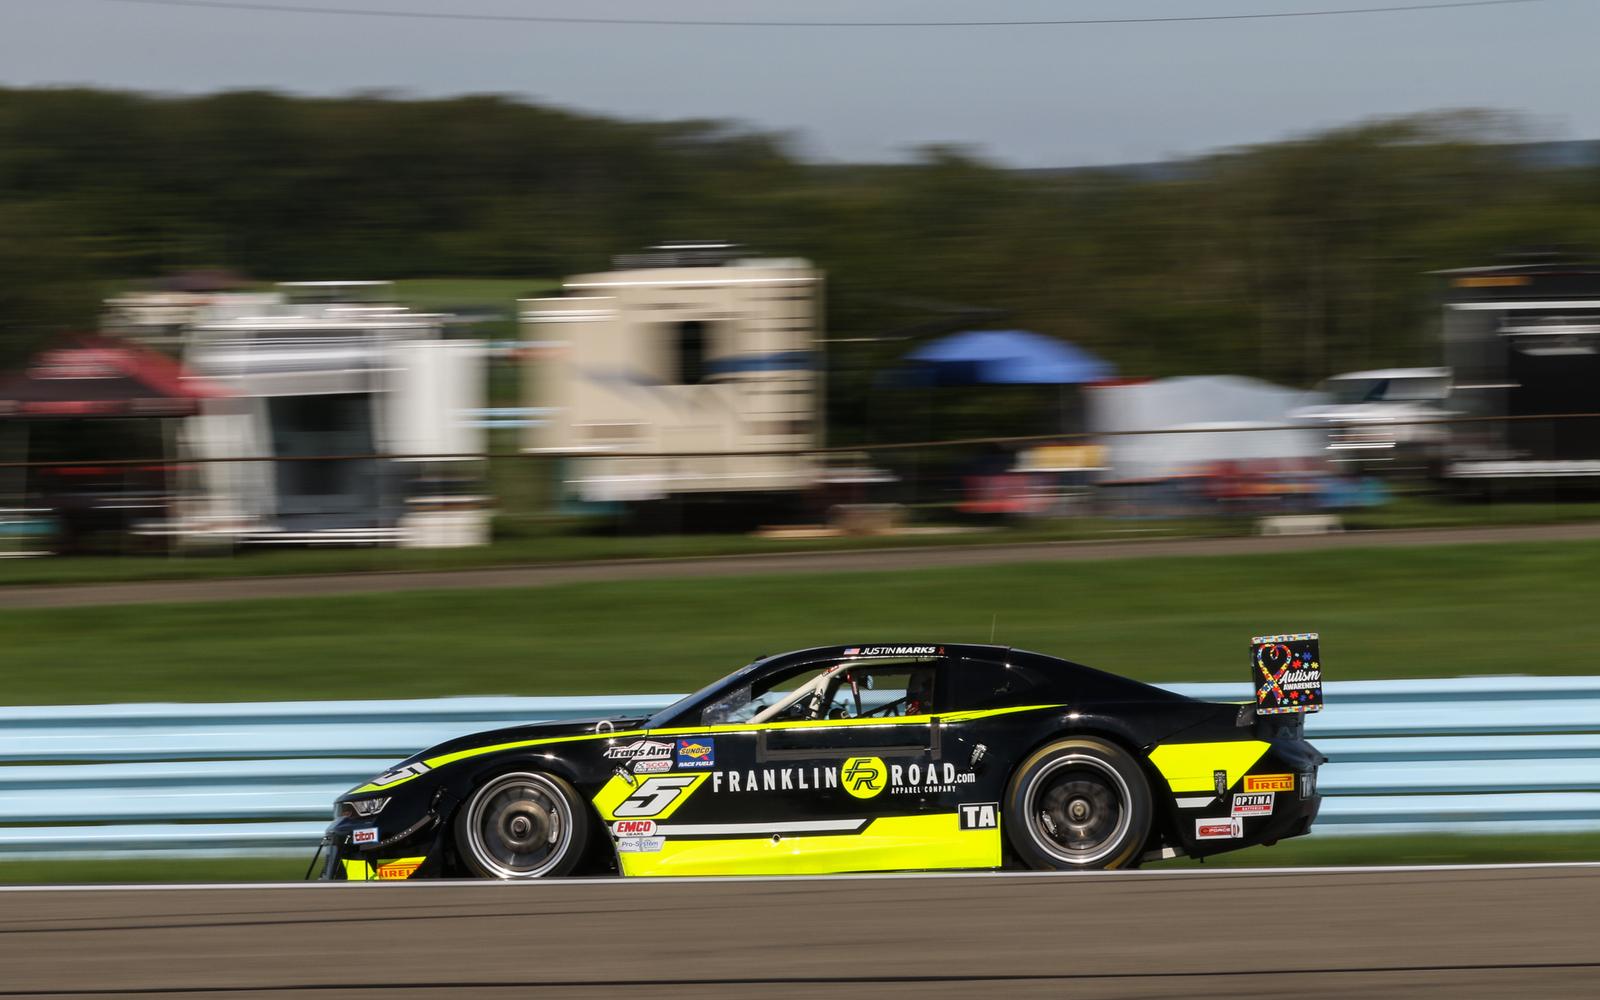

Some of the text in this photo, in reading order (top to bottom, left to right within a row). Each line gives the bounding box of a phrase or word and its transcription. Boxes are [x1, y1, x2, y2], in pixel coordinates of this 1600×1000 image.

[1278, 669, 1322, 684] Autism
[1283, 681, 1321, 691] AWARENESS
[609, 745, 671, 758] Trans Am
[680, 747, 711, 756] SUNOCO
[713, 766, 837, 792] FRANKLIN
[1247, 775, 1293, 791] PIRELLI
[891, 785, 956, 794] APPAREL COMPANY
[613, 776, 699, 817] 5
[1235, 795, 1272, 806] OPTIMA
[962, 805, 996, 828] TA
[617, 821, 652, 833] EMCO
